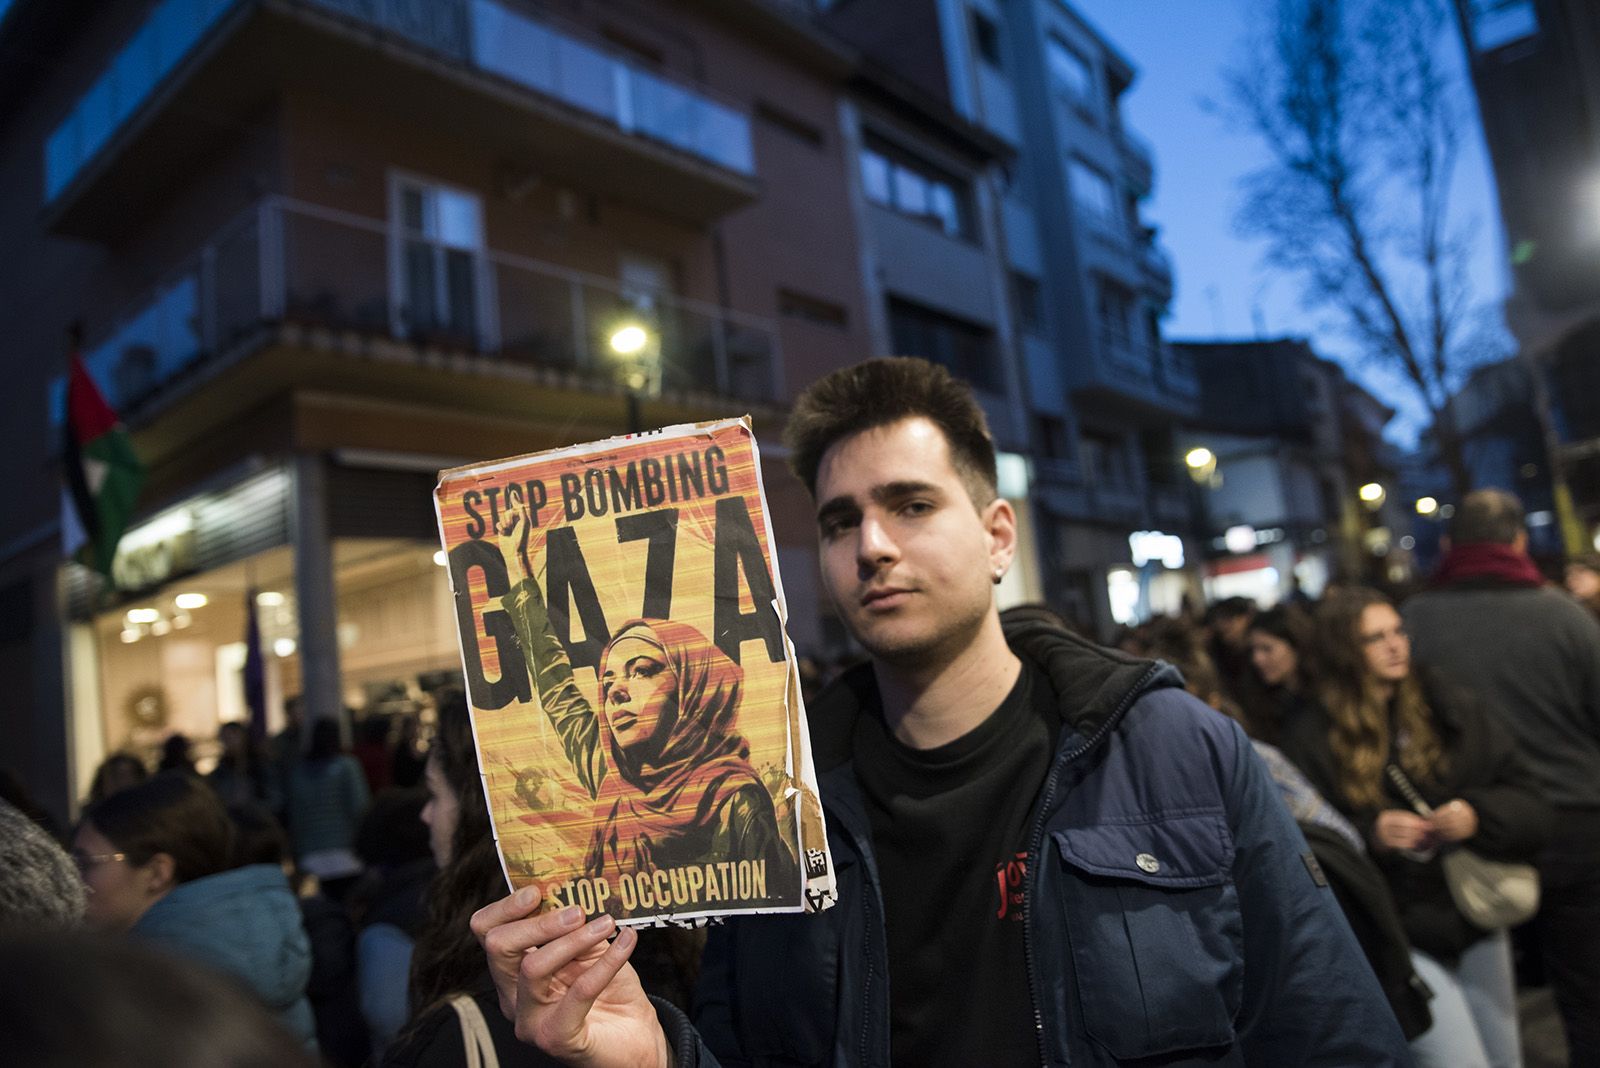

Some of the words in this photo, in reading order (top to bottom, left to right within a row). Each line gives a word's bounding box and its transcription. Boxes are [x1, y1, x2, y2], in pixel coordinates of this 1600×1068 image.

[560, 445, 730, 522] BOMBING
[449, 496, 786, 711] GAZA
[546, 877, 611, 915] STOP
[619, 859, 767, 911] OCCUPATION
